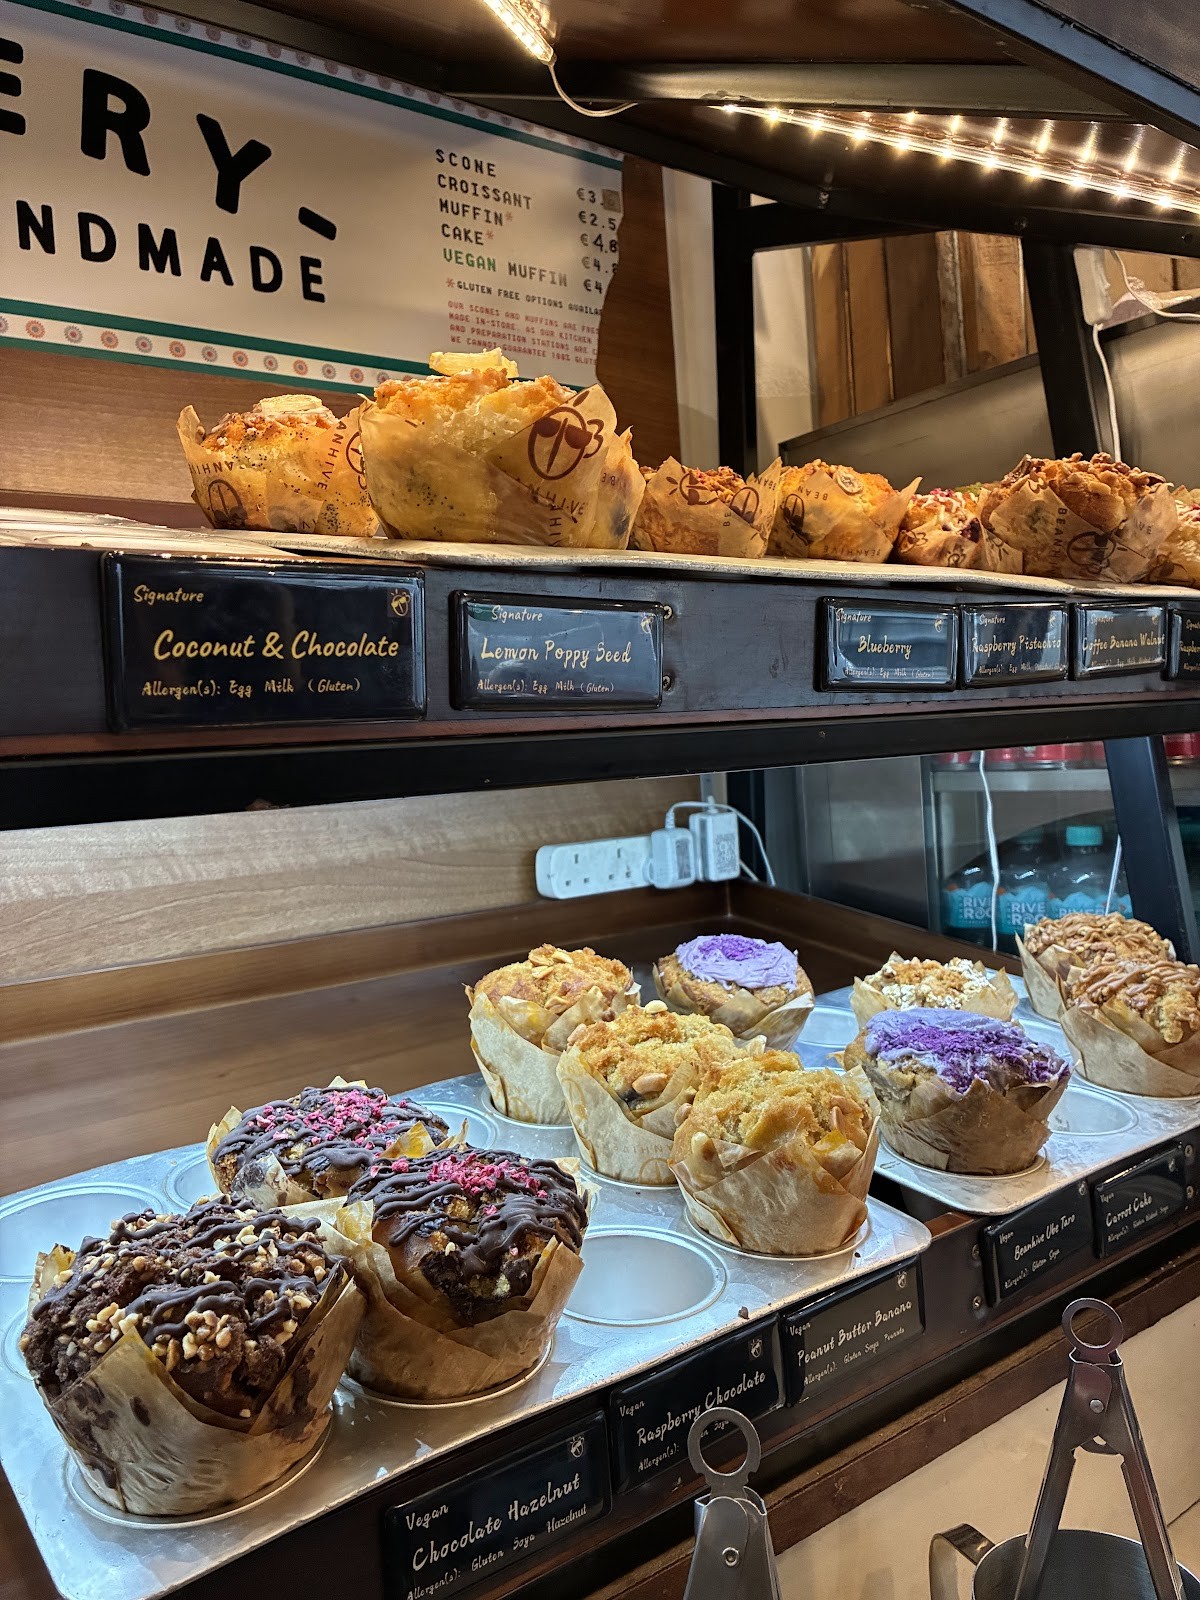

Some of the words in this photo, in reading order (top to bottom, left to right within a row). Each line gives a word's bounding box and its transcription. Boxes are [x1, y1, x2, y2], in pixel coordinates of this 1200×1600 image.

[435, 149, 496, 177] SCONE
[437, 174, 532, 210] CROISSANT
[16, 200, 326, 303] NDMADE
[443, 247, 496, 272] VEGAN
[508, 262, 567, 287] MUFFIN
[497, 288, 520, 301] FREE
[525, 294, 563, 309] OPTIONS
[447, 300, 464, 310] OUR
[470, 304, 500, 316] SCONES
[504, 311, 520, 320] AND
[525, 315, 558, 327] MUFFINS
[448, 312, 470, 323] MADE
[559, 332, 592, 344] KITCHEN
[449, 323, 466, 333] AND
[471, 327, 527, 343] PREPARATION
[532, 338, 569, 350] STATIONS
[450, 335, 461, 344] WE
[466, 337, 497, 348] CANNOT
[133, 584, 204, 605] Signature
[491, 604, 543, 624] Signature
[835, 608, 872, 624] Signature
[980, 614, 1006, 627] Signature
[154, 629, 255, 661] Coconut
[262, 631, 285, 660] &
[291, 629, 399, 660] Chocolate
[481, 636, 540, 661] Lemon
[544, 640, 590, 669] Poppy
[595, 641, 632, 664] Seed
[858, 634, 912, 660] Blueberry
[972, 634, 1017, 658] Raspberry
[1019, 634, 1061, 651] Pistachio
[1082, 637, 1108, 655] Coffee
[1110, 635, 1138, 650] Banana
[1140, 631, 1165, 646] Walnut
[229, 682, 253, 699] Egg
[264, 678, 295, 694] Milk
[532, 681, 548, 694] Egg
[555, 680, 575, 692] Milk
[1105, 1203, 1132, 1228] Carrot
[1133, 1192, 1152, 1212] Cake
[999, 1231, 1014, 1244] Vegan
[1014, 1233, 1045, 1261] Beanhive
[1046, 1222, 1059, 1240] Ube
[1060, 1214, 1076, 1230] Taro
[790, 1321, 811, 1337] Vegan
[797, 1336, 835, 1367] Peanut
[838, 1319, 872, 1347] Butter
[874, 1300, 913, 1327] Banana
[843, 1351, 862, 1364] Gluten
[864, 1340, 880, 1354] Soya
[619, 1400, 646, 1417] Vegan
[637, 1404, 701, 1447] Raspberry
[705, 1370, 766, 1410] Chocolate
[405, 1503, 449, 1531] Vegan
[412, 1519, 502, 1572] Chocolate
[508, 1472, 580, 1522] Hazelnut
[471, 1549, 505, 1572] Gluten
[513, 1533, 536, 1551] Soya
[546, 1503, 588, 1533] Hazelnut
